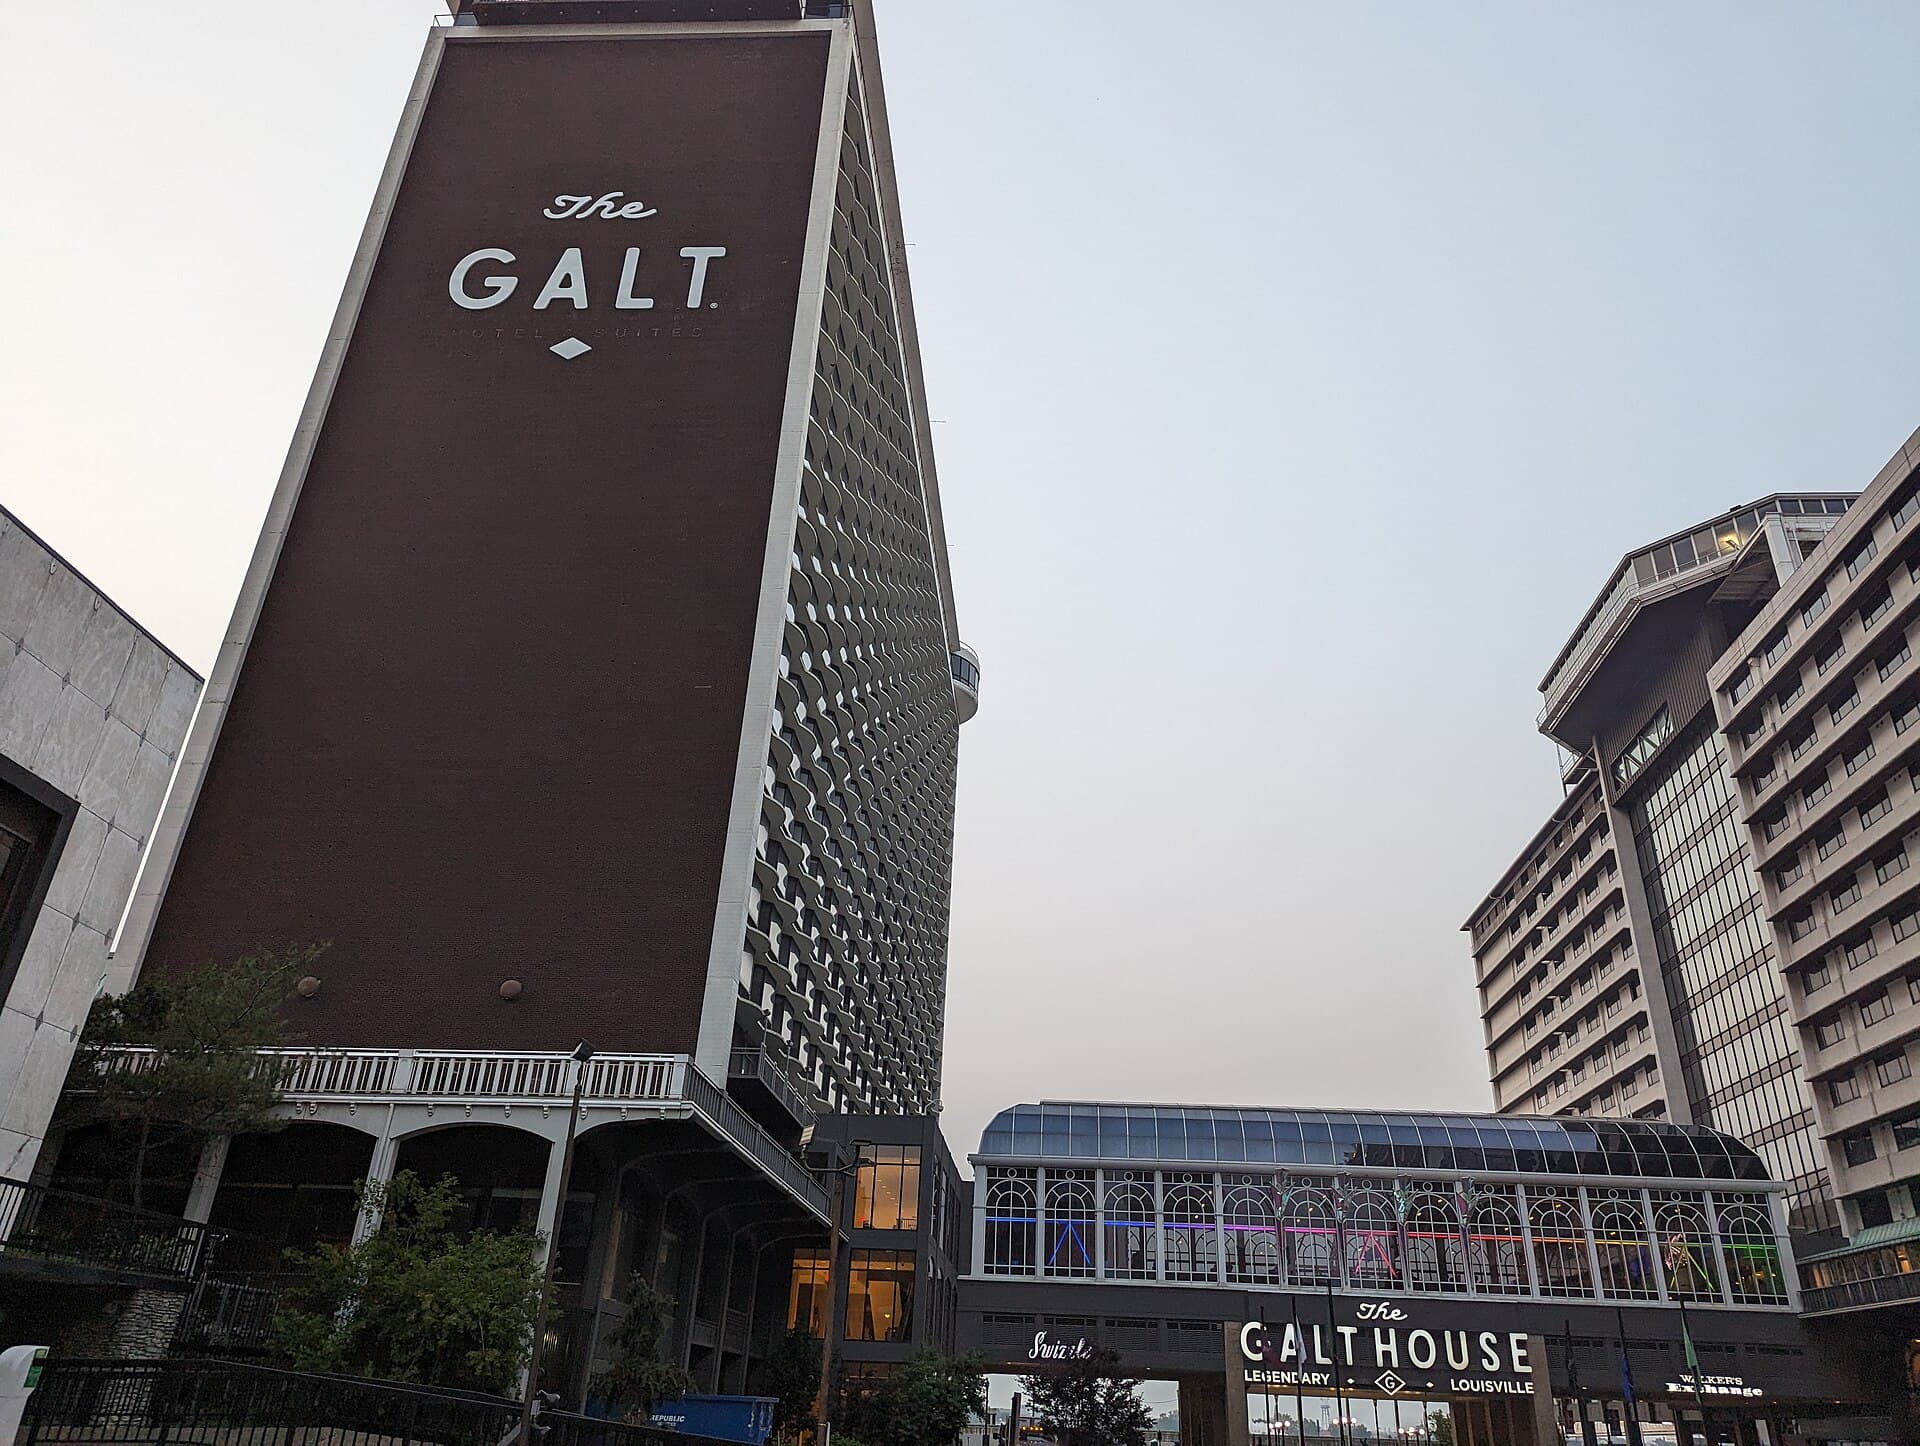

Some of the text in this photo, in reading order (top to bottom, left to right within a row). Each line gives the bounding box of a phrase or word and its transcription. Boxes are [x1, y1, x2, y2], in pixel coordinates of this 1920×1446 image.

[543, 191, 657, 220] The
[448, 246, 727, 310] GALT
[1355, 1301, 1408, 1321] The
[1240, 1321, 1533, 1374] GALT HOUSE
[1244, 1369, 1331, 1386] LEGENDARY
[1450, 1378, 1535, 1395] LOUISVILLE
[1679, 1374, 1744, 1386] WLKER'S
